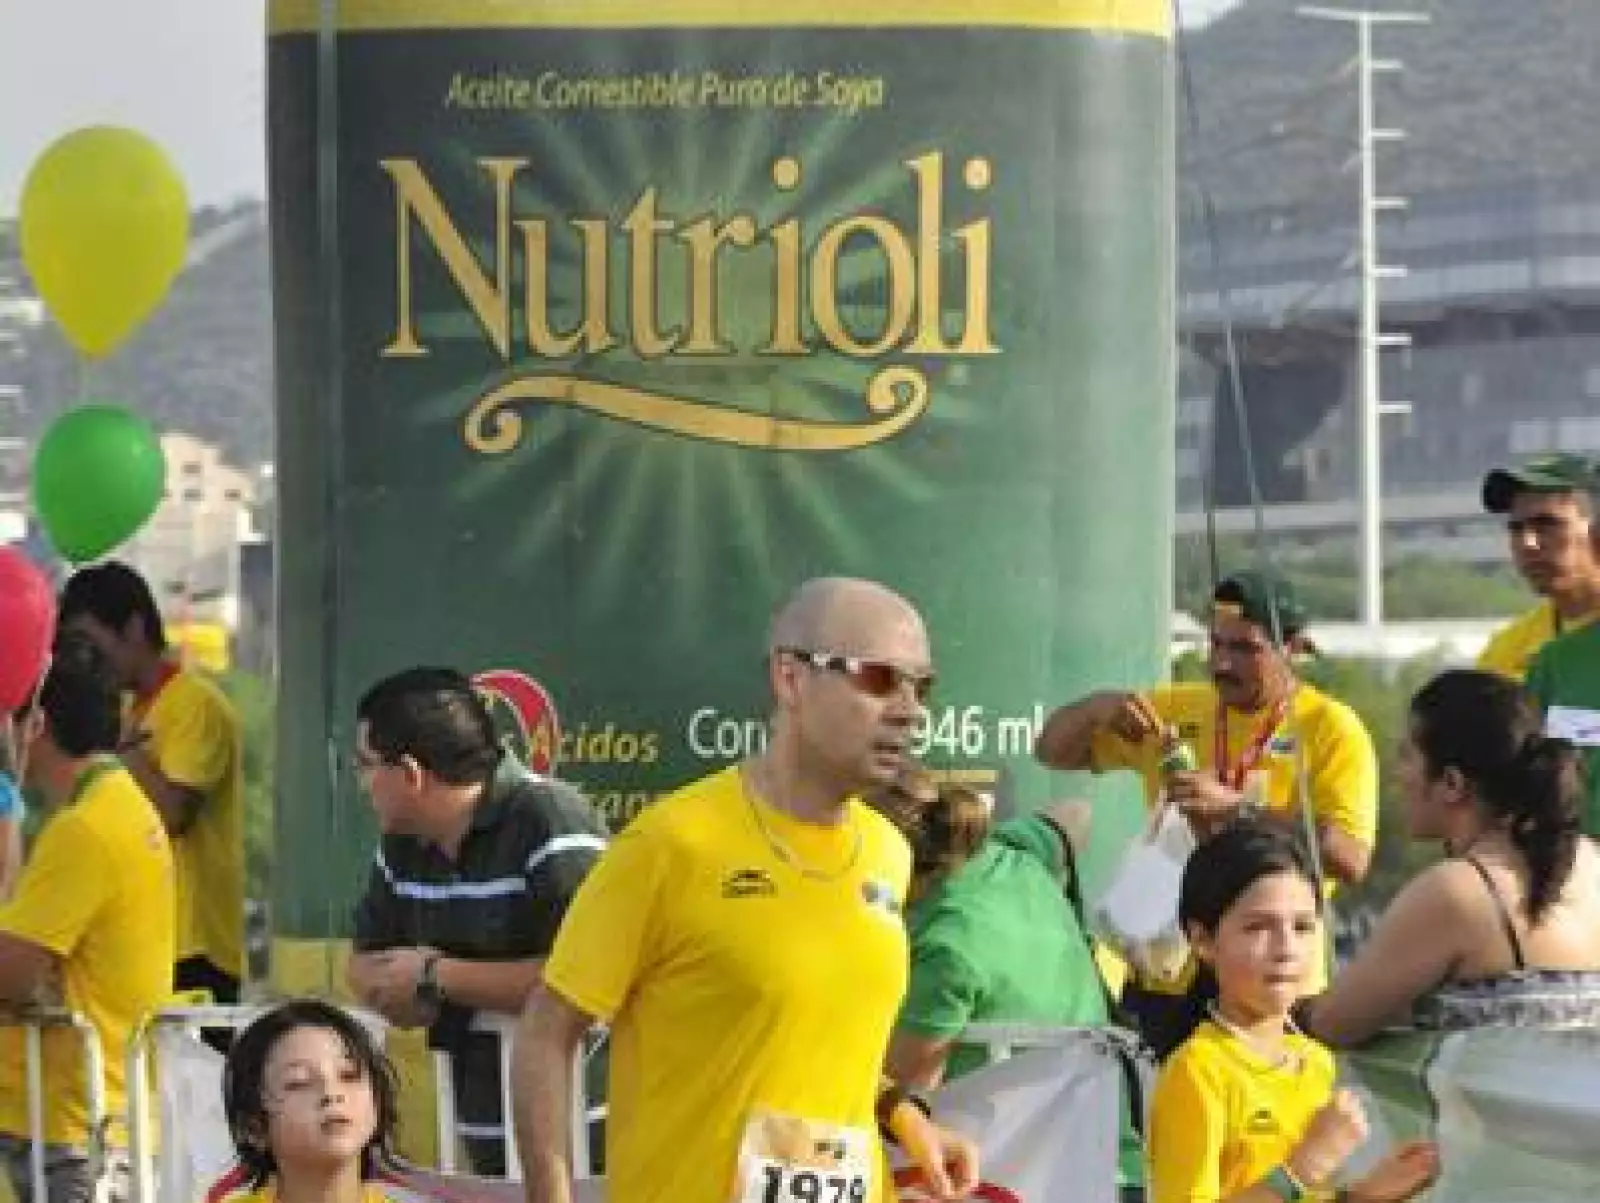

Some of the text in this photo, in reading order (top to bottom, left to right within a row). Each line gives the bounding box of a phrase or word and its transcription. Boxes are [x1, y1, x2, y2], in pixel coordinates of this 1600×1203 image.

[536, 70, 695, 109] Comestible
[773, 69, 809, 107] de
[378, 150, 1003, 361] Nutrioli
[690, 706, 767, 758] Con
[909, 705, 986, 758] 946
